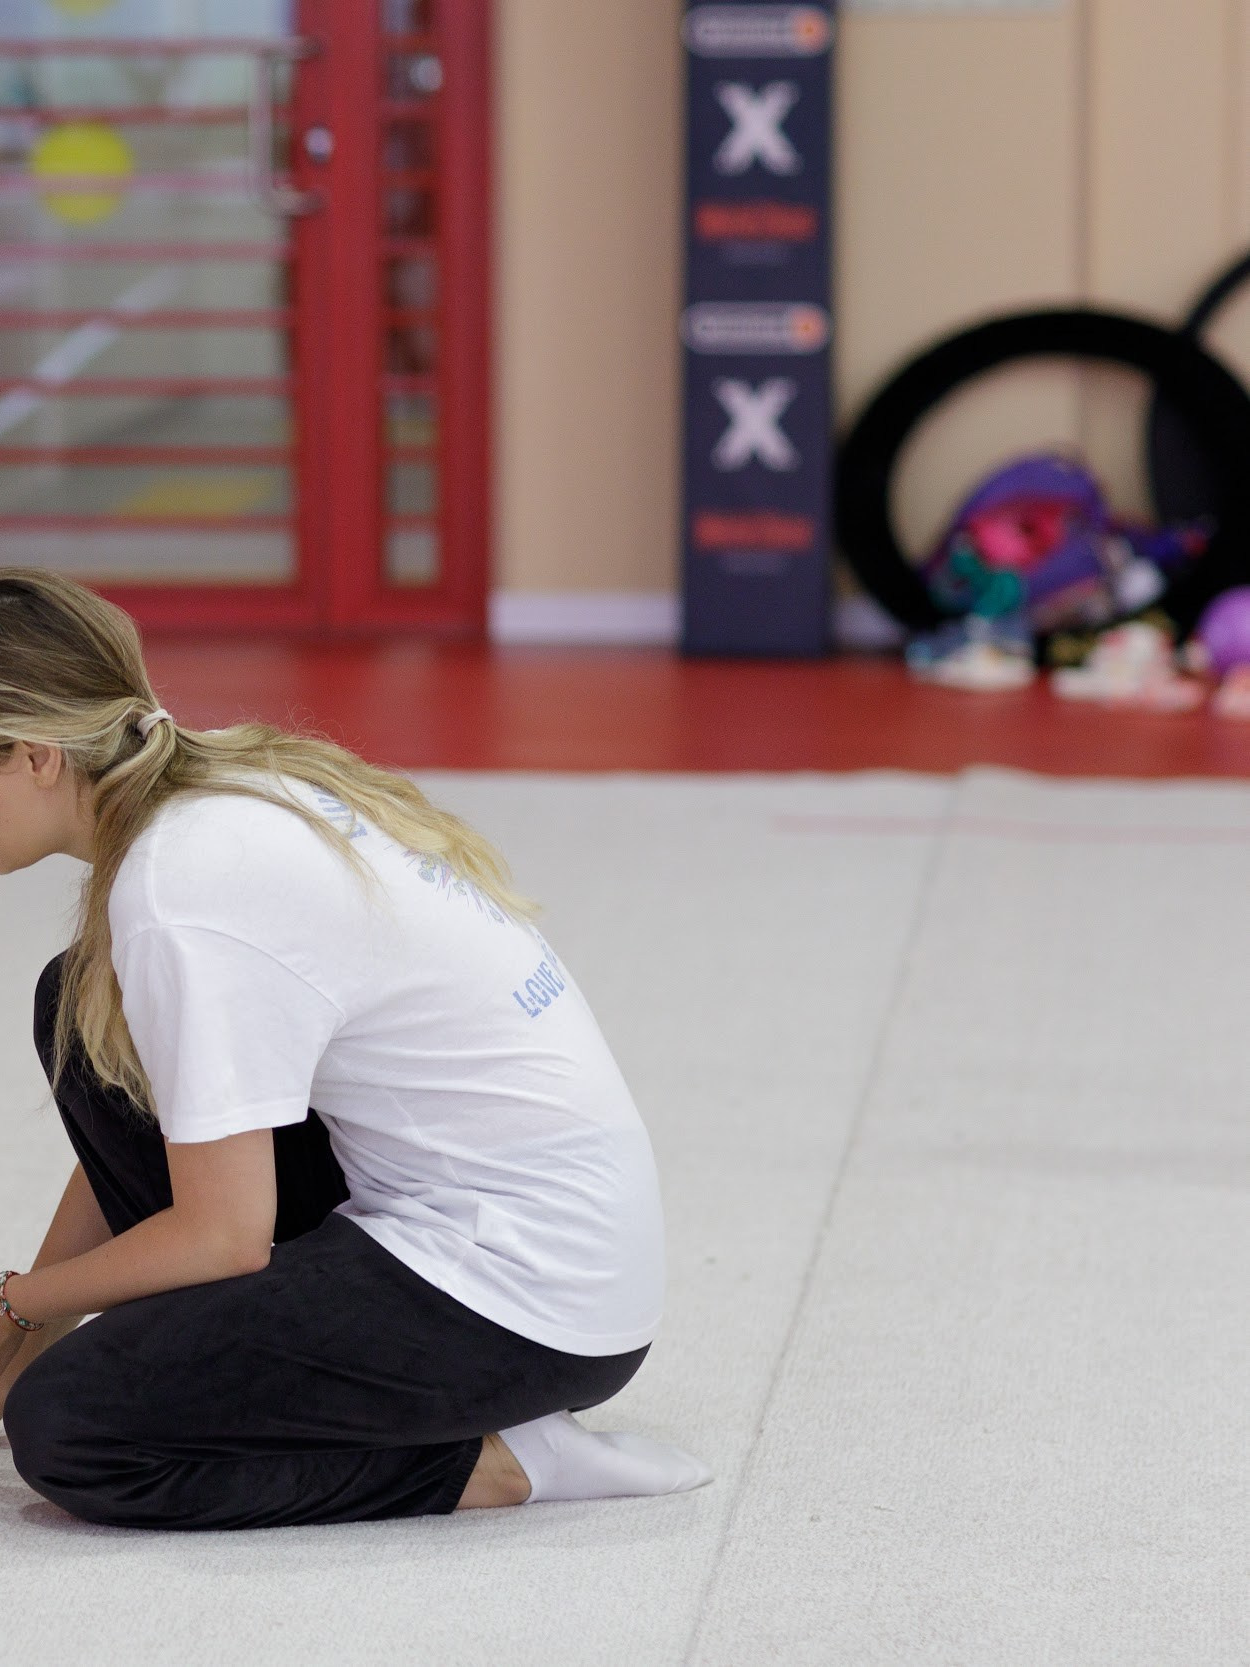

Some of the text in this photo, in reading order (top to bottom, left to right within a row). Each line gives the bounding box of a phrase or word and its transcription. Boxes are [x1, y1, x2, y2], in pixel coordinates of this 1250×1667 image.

[720, 83, 796, 172] X
[718, 380, 793, 469] X
[512, 961, 565, 1018] LOVE
